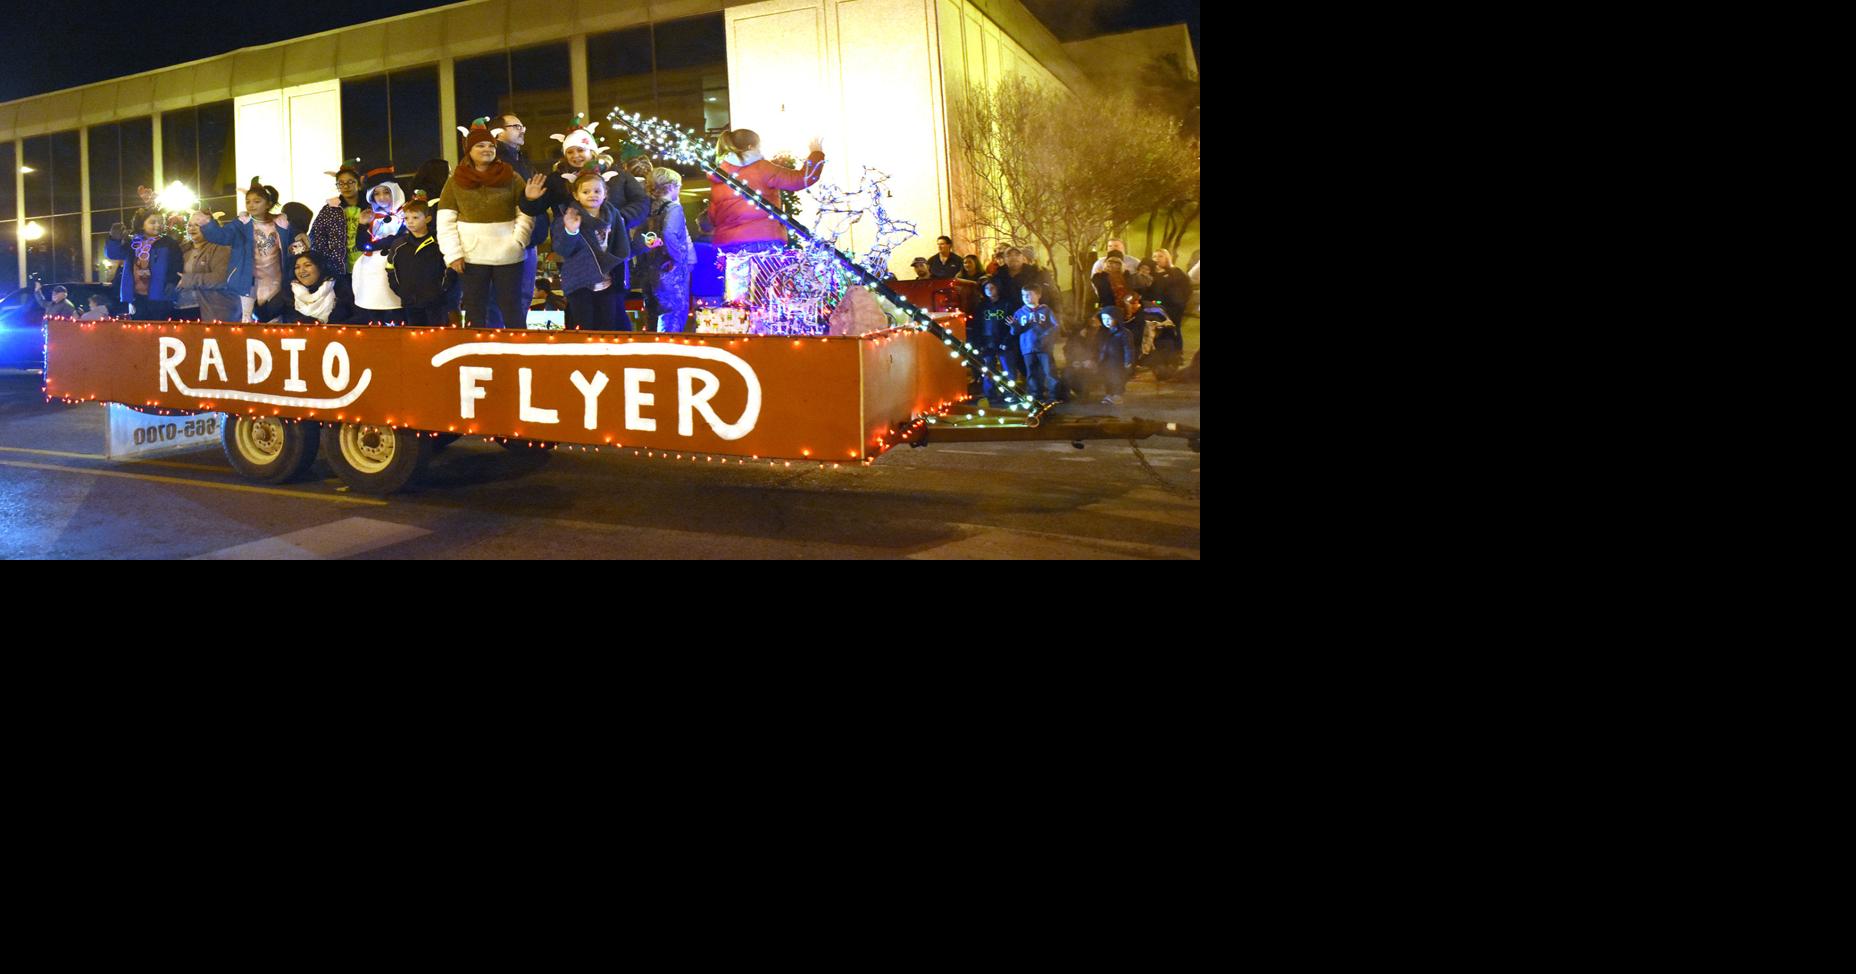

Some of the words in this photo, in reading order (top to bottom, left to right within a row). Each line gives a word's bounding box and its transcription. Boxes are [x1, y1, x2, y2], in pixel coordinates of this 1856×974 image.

[1021, 312, 1046, 327] GAP
[159, 337, 372, 409] RADIO
[459, 365, 762, 440] FLYER
